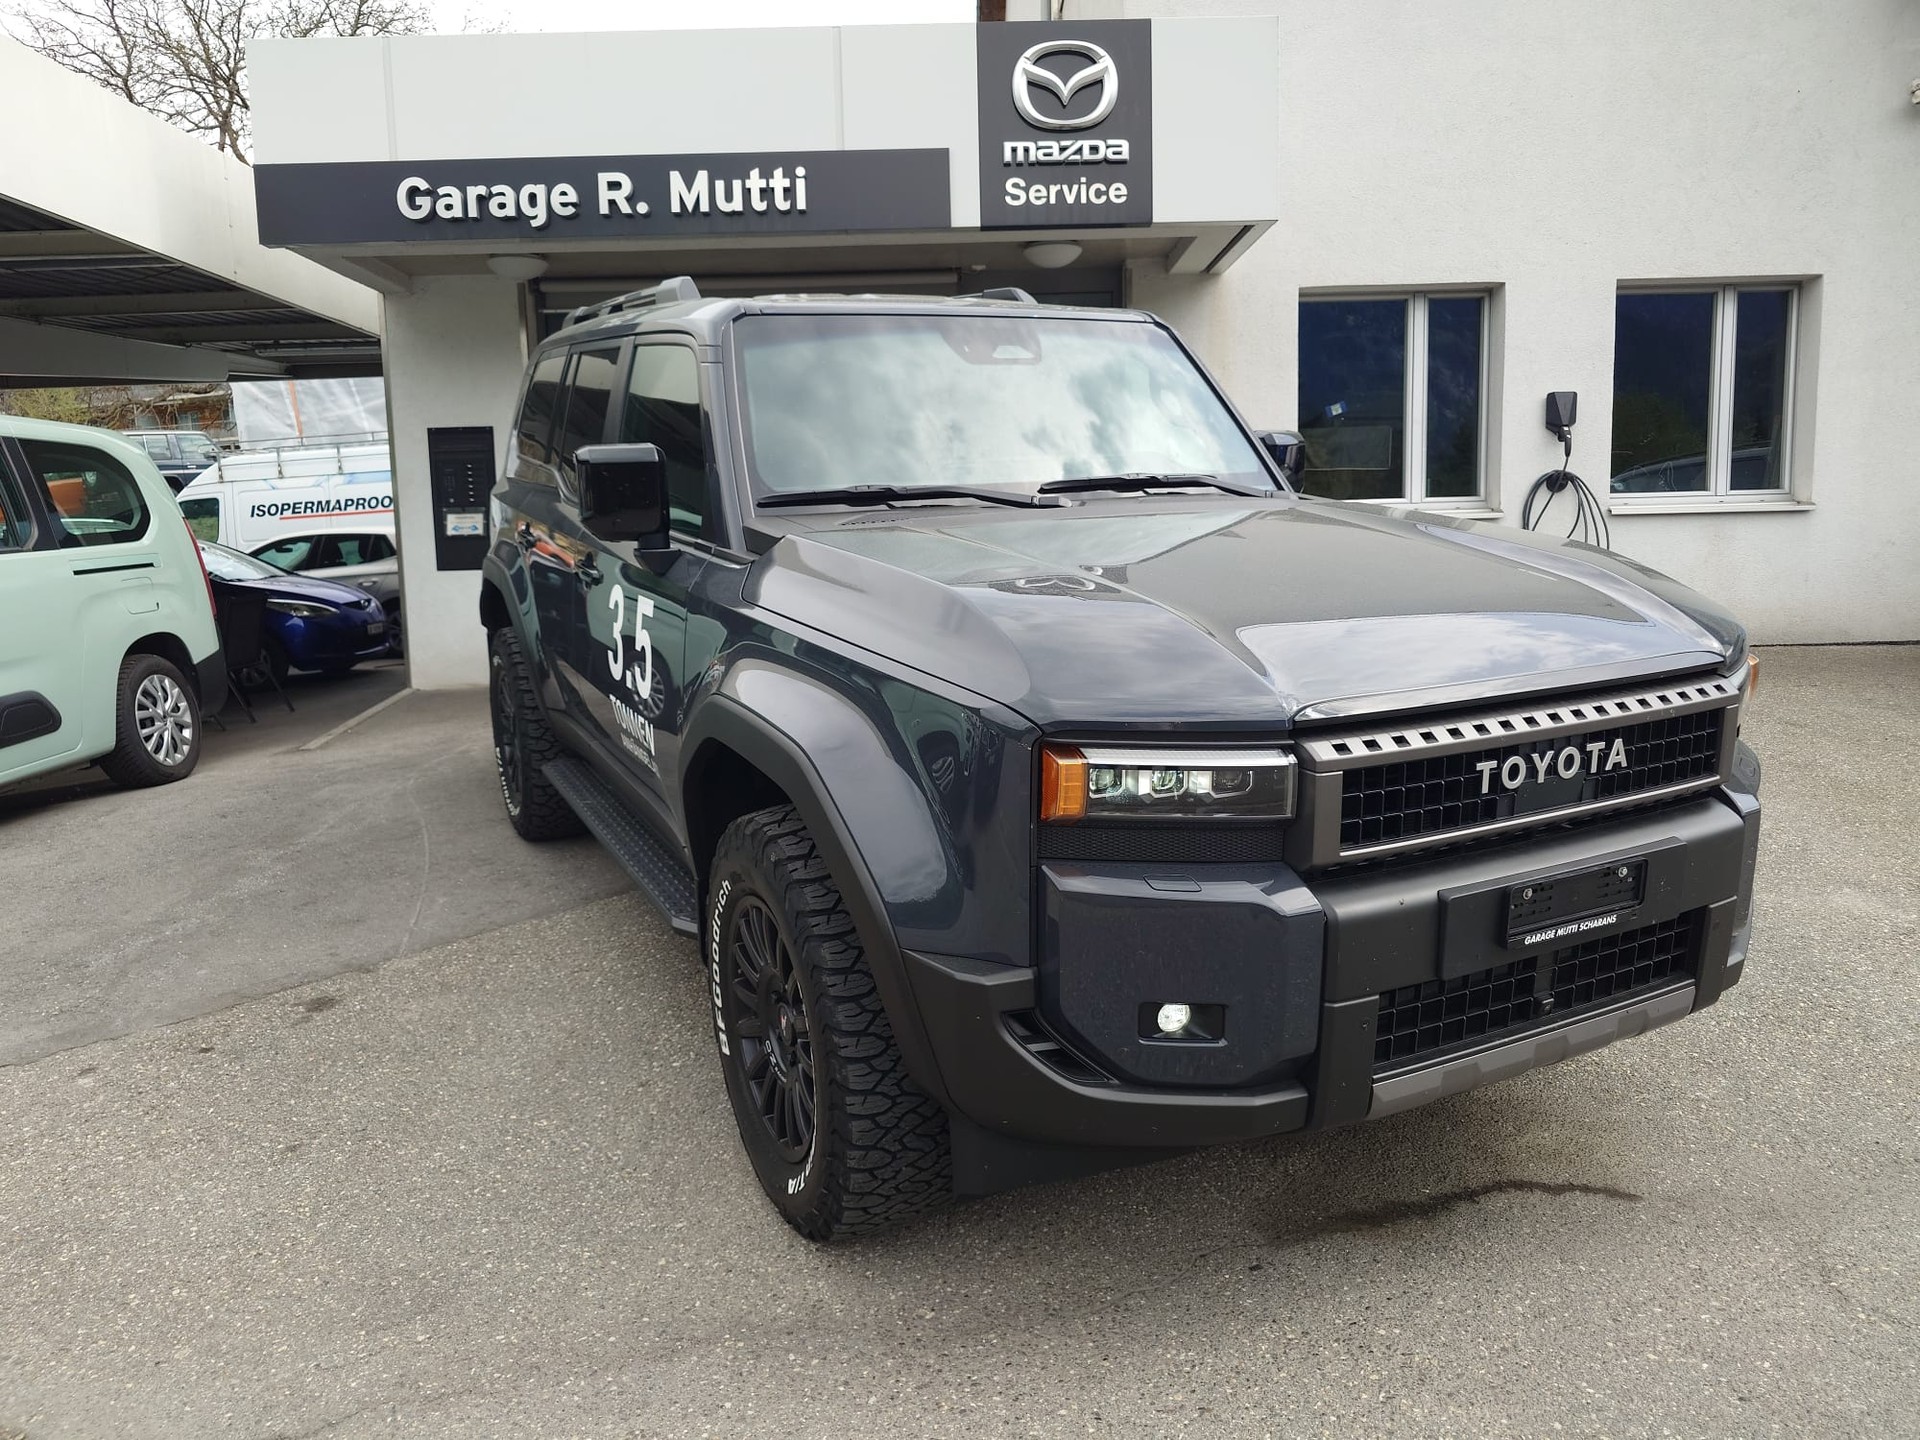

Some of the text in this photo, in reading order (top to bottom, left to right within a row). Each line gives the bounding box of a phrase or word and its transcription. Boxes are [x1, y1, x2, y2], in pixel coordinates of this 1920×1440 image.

[396, 166, 808, 229] Garage R. Mutti
[1004, 177, 1128, 206] Service
[607, 584, 655, 699] 3.5
[608, 693, 655, 756] TONNEN
[1476, 738, 1628, 793] TOYOTA
[1524, 914, 1617, 945] GARAGE MUTTI SCHARANS
[712, 879, 732, 1056] BFGoodrich
